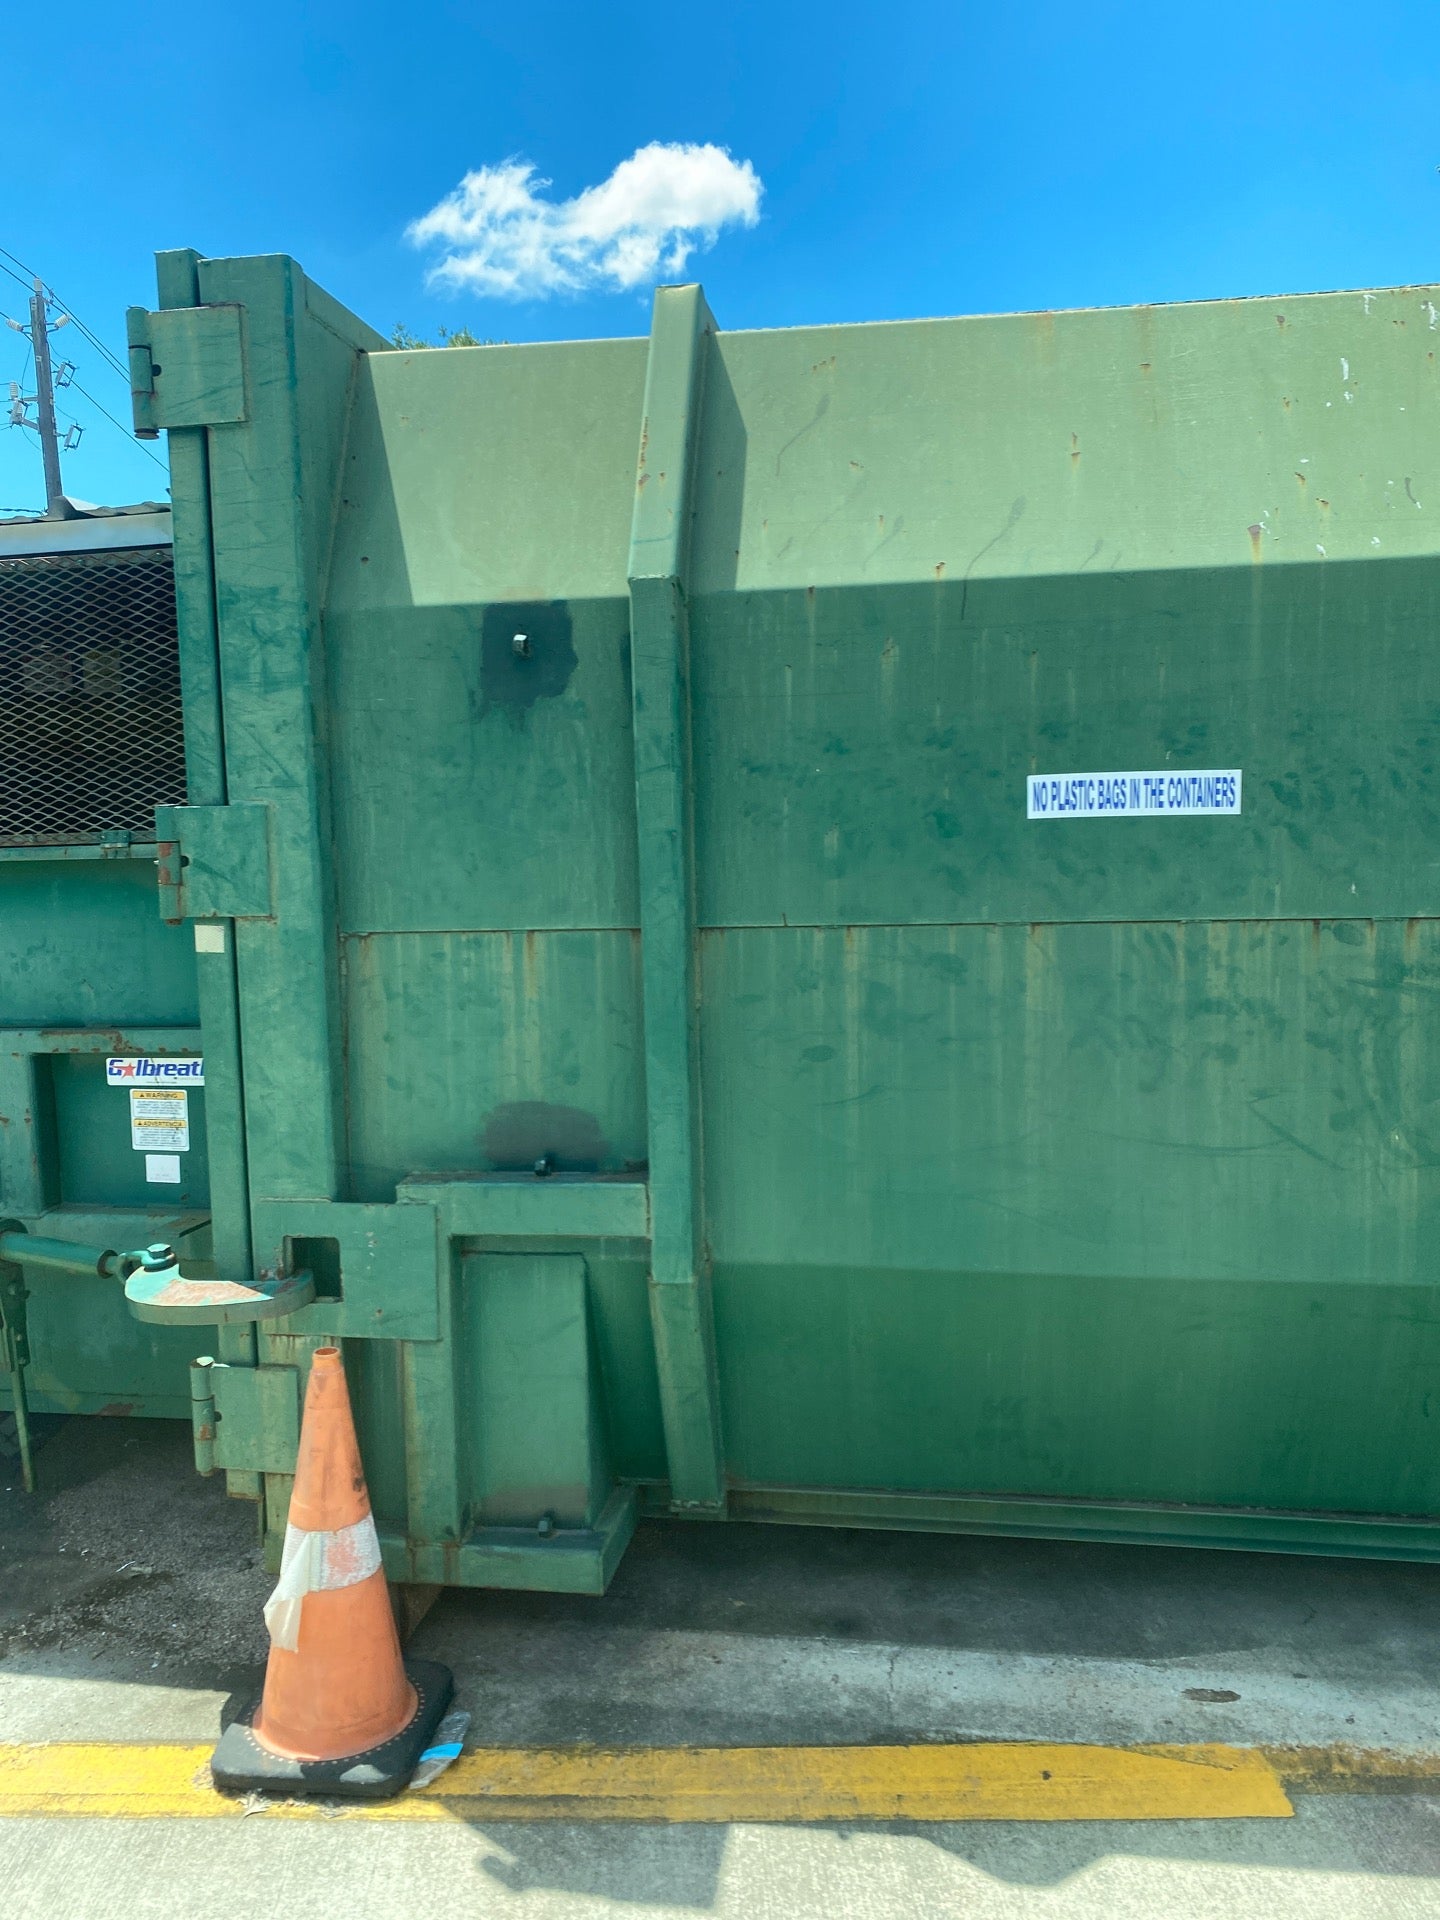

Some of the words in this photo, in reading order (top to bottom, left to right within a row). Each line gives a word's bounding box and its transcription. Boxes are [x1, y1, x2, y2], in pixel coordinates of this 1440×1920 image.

[1032, 781, 1048, 811] NO
[1051, 779, 1096, 811] PLASTIC
[1098, 778, 1127, 810] BAGS
[1129, 778, 1141, 809] IN
[1143, 777, 1165, 809] THE
[1168, 776, 1236, 809] CONTAINERS
[108, 1059, 204, 1078] Glbreat
